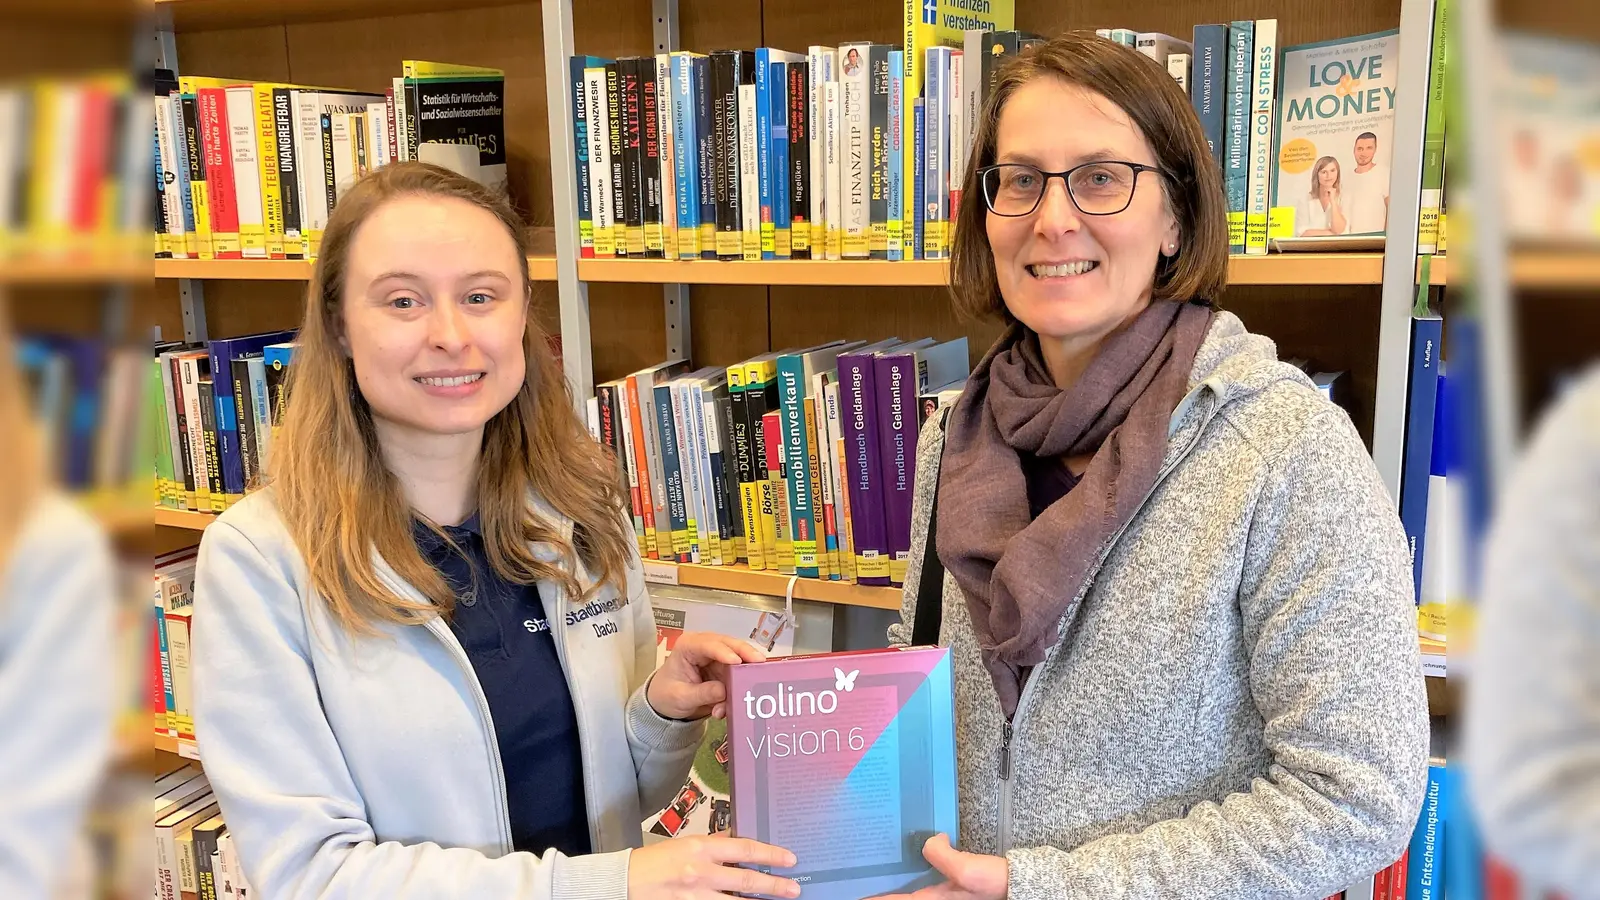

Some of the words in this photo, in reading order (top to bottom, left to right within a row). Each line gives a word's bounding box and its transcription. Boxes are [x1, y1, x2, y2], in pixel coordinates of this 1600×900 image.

[1234, 33, 1246, 81] nebenan
[1310, 55, 1382, 88] LOVE
[610, 72, 618, 91] GELD
[644, 82, 654, 94] DA
[680, 56, 690, 95] campus
[880, 60, 889, 94] Hasler
[1335, 74, 1360, 97] &
[1436, 74, 1444, 90] Kunst
[209, 95, 218, 124] Zeiten
[386, 96, 394, 122] TEILEN
[421, 109, 435, 120] und
[436, 106, 501, 119] Sozialwissenschaftler
[423, 94, 450, 105] Statistik
[450, 93, 460, 104] für
[461, 92, 499, 103] Wirtschafts-
[611, 92, 619, 118] NEUES
[627, 76, 640, 149] KAUFEN!
[645, 96, 656, 109] IST
[798, 102, 803, 110] es
[851, 82, 860, 122] BUCH
[1286, 86, 1396, 122] MONEY
[201, 94, 211, 141] Ökonomie
[260, 92, 273, 136] RELATIV
[645, 112, 656, 138] CRASH
[715, 98, 724, 158] MASCHMEYER
[212, 126, 221, 150] harte
[264, 140, 272, 151] IST
[275, 95, 293, 172] UNANGREIFBAR
[322, 133, 332, 159] WISSEN
[388, 125, 396, 145] WELT
[407, 114, 417, 161] DUMMIES
[579, 121, 589, 160] Geld
[612, 119, 620, 156] SCHÖNES
[726, 90, 737, 188] MILLIONÄRSFORMEL
[872, 126, 881, 168] werden
[1230, 109, 1242, 168] Millionärin
[188, 127, 198, 171] DUMMIES
[206, 144, 214, 166] Gute
[214, 153, 223, 166] für
[646, 140, 658, 158] DER
[678, 144, 686, 178] EINFACH
[700, 139, 708, 178] Geldanlage
[265, 156, 276, 187] TEUER
[324, 159, 333, 186] WILDES
[615, 163, 623, 188] HÄRING
[707, 159, 715, 196] unsicheren
[852, 127, 861, 204] FINANZTIP
[700, 180, 708, 204] Sichere
[717, 162, 725, 201] CARSTEN
[795, 161, 803, 201] Hagelüken
[872, 170, 881, 200] Reich
[883, 188, 888, 200] an
[616, 189, 624, 218] NORBERT
[729, 190, 738, 208] DIE
[852, 209, 860, 225] AS
[682, 392, 690, 417] verkaufen
[852, 367, 863, 429] Geldanlage
[891, 366, 902, 429] Geldanlage
[694, 393, 705, 437] Altersvorsorge
[685, 418, 694, 447] erfolgreich
[754, 420, 768, 468] DUMMIES
[782, 371, 807, 510] Immobilienverkauf
[688, 448, 697, 474] Immobilie
[698, 438, 707, 459] Private
[736, 424, 749, 471] DUMMIES
[856, 434, 869, 489] Handbuch
[894, 434, 906, 490] Handbuch
[206, 453, 214, 478] ZEITEN
[672, 471, 681, 485] GELD
[667, 477, 674, 485] DU
[674, 485, 682, 501] KANN
[776, 480, 786, 503] RENTE
[676, 501, 684, 518] JEDER
[762, 484, 773, 514] Börse
[779, 513, 788, 526] REICH
[653, 610, 674, 620] iftung
[160, 650, 172, 695] WIRTSCHAFT
[744, 682, 838, 720] tolino
[747, 725, 839, 759] vision
[848, 727, 864, 751] 6
